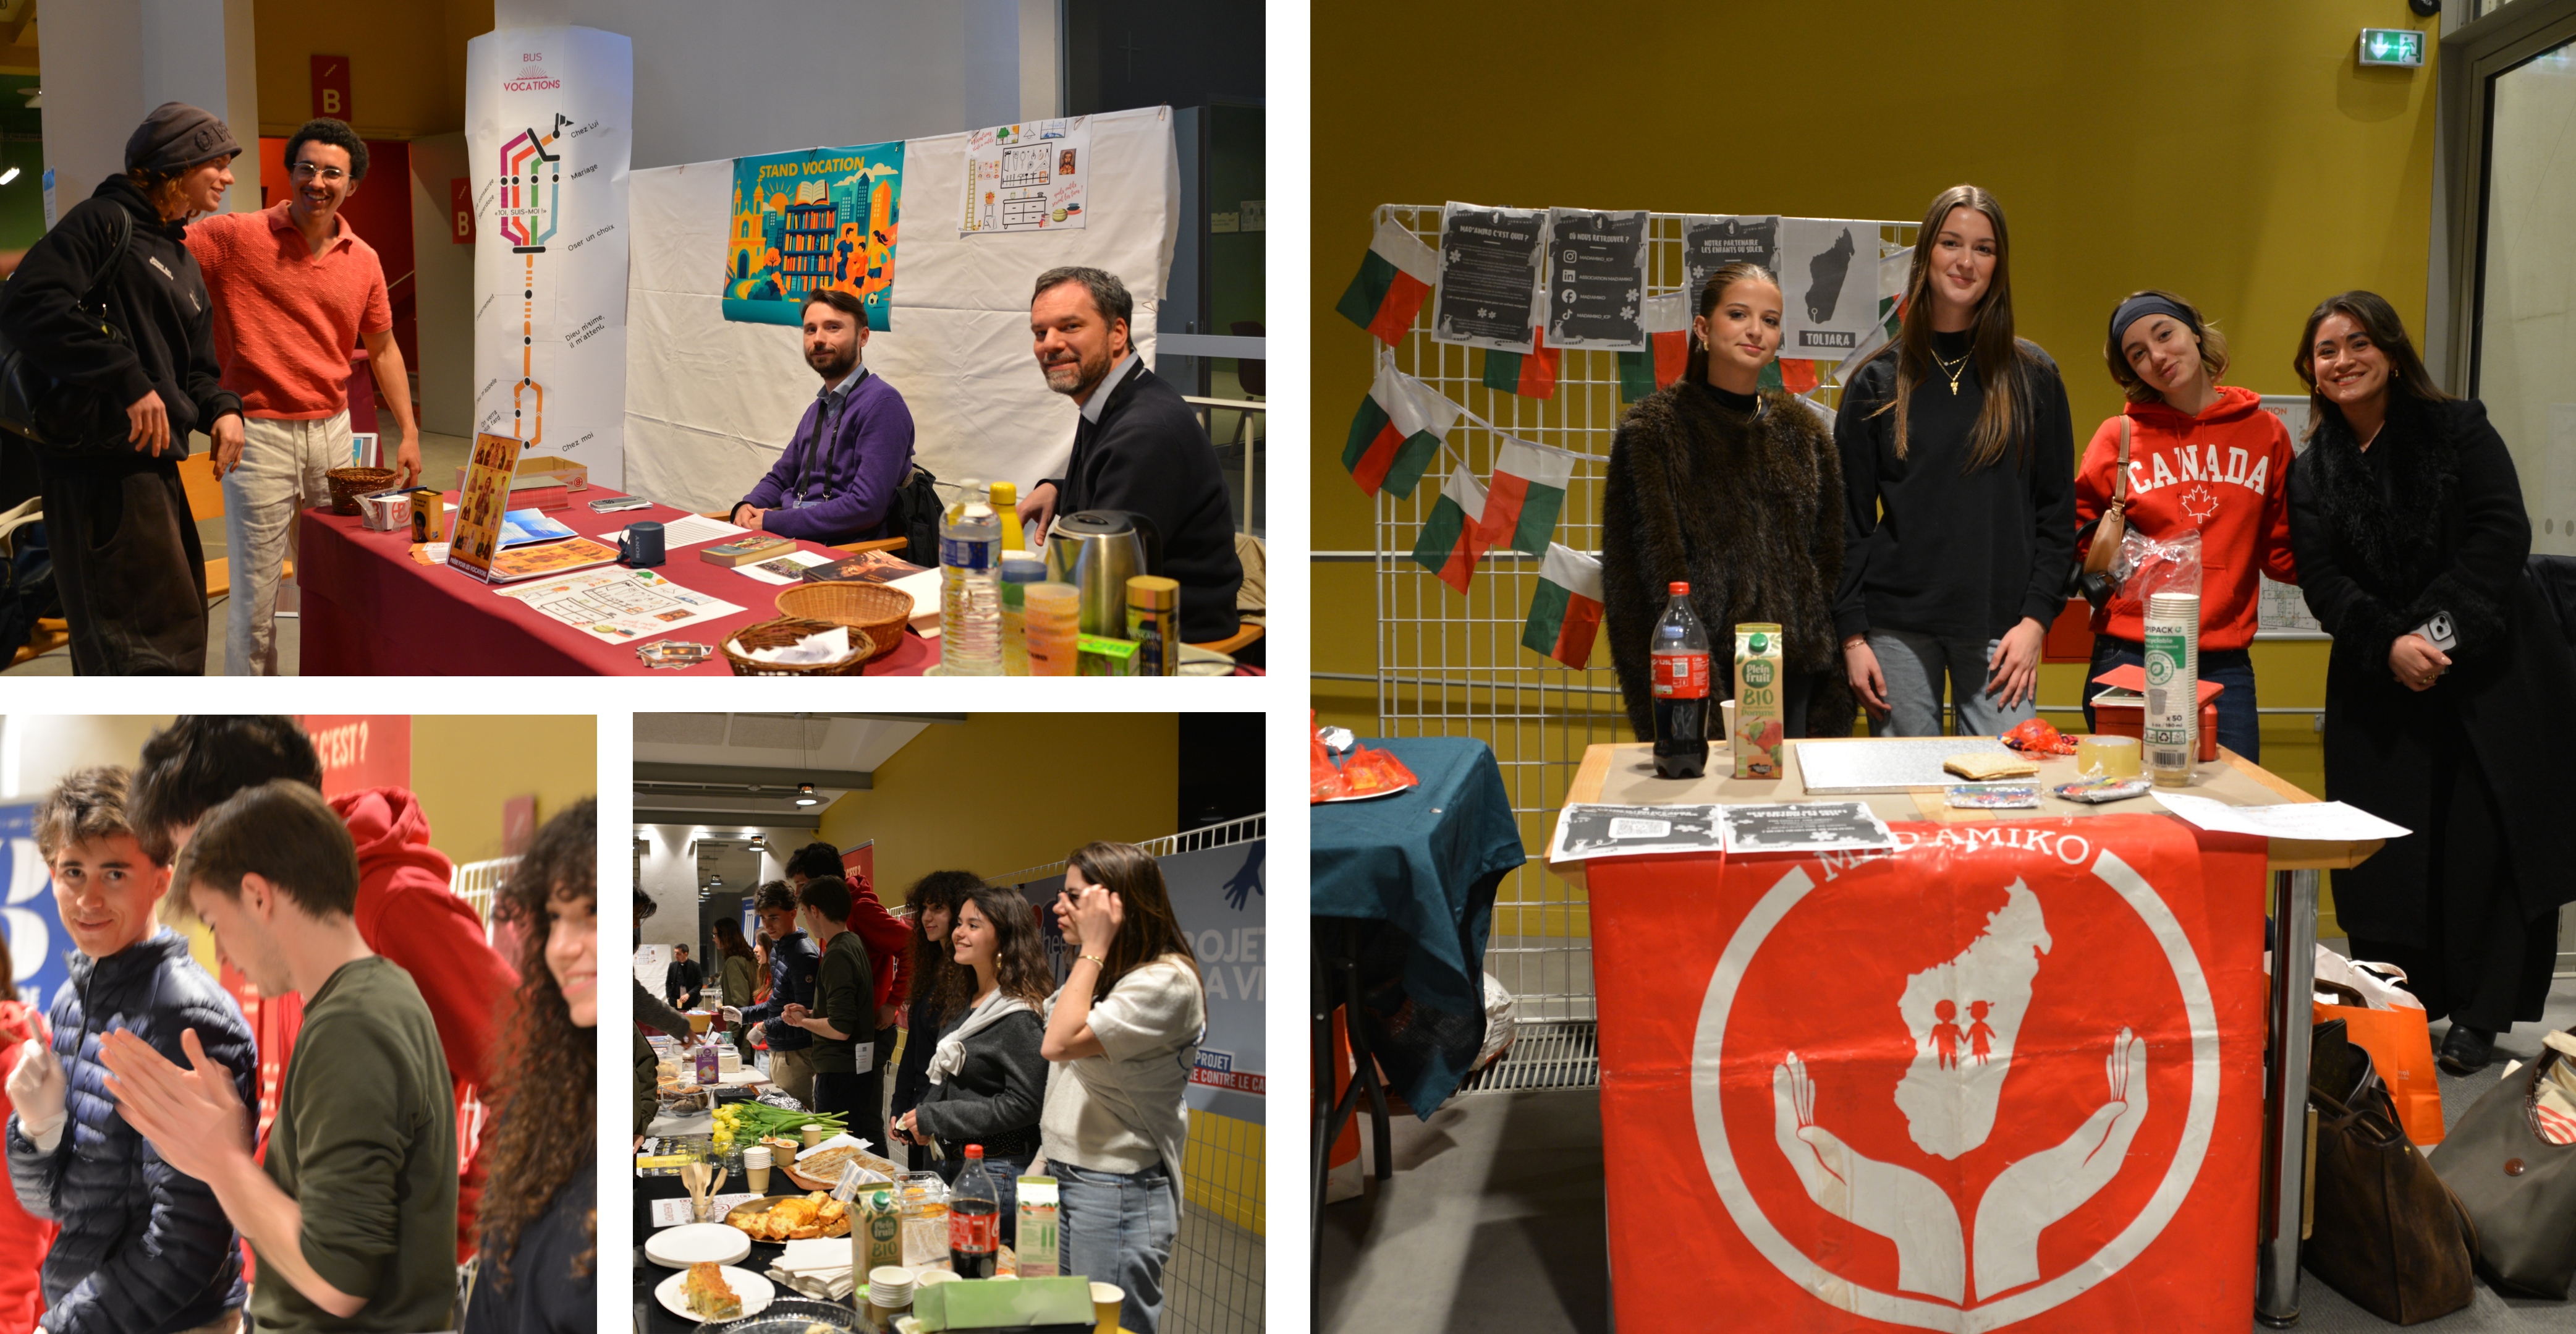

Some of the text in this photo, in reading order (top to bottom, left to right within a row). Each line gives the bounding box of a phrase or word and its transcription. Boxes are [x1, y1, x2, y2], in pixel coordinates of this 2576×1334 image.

[523, 53, 543, 62] BUS
[504, 80, 561, 91] VOCATIONS
[323, 88, 341, 114] B
[570, 125, 588, 139] Chez
[570, 163, 598, 181] Mariage
[758, 156, 865, 179] STAND VOCATION
[478, 178, 494, 203] consacrée
[478, 194, 495, 220] Sacerdoce
[457, 211, 470, 236] B
[567, 223, 616, 252] Oser un choix
[1459, 225, 1529, 242] MAD'AMIKO C'EST QUOI ?
[1577, 233, 1591, 241] NOUS
[1592, 235, 1624, 243] RETROUVER
[1738, 245, 1745, 253] DU
[1746, 245, 1764, 253] SOLEIL
[565, 329, 581, 342] Dieu
[569, 340, 575, 349] il
[480, 409, 498, 429] On verra
[491, 414, 501, 426] tard
[561, 431, 595, 452] Chez moi
[2127, 444, 2269, 496] CANADA
[450, 557, 459, 567] PRIÈRE
[458, 561, 466, 569] POUR
[470, 566, 487, 577] VOCATIONS
[1747, 662, 1769, 674] Plein
[1746, 671, 1771, 684] fruit
[1743, 689, 1774, 705] BIO
[1741, 709, 1776, 717] Pomme
[319, 720, 369, 773] C'EST ?
[1182, 927, 1266, 964] OJE
[1195, 1050, 1230, 1071] PROJET
[1201, 1069, 1236, 1088] CONTRE
[1238, 1074, 1249, 1090] LE
[874, 1220, 894, 1230] Plein
[874, 1228, 894, 1238] fruit
[871, 1241, 897, 1257] BIO
